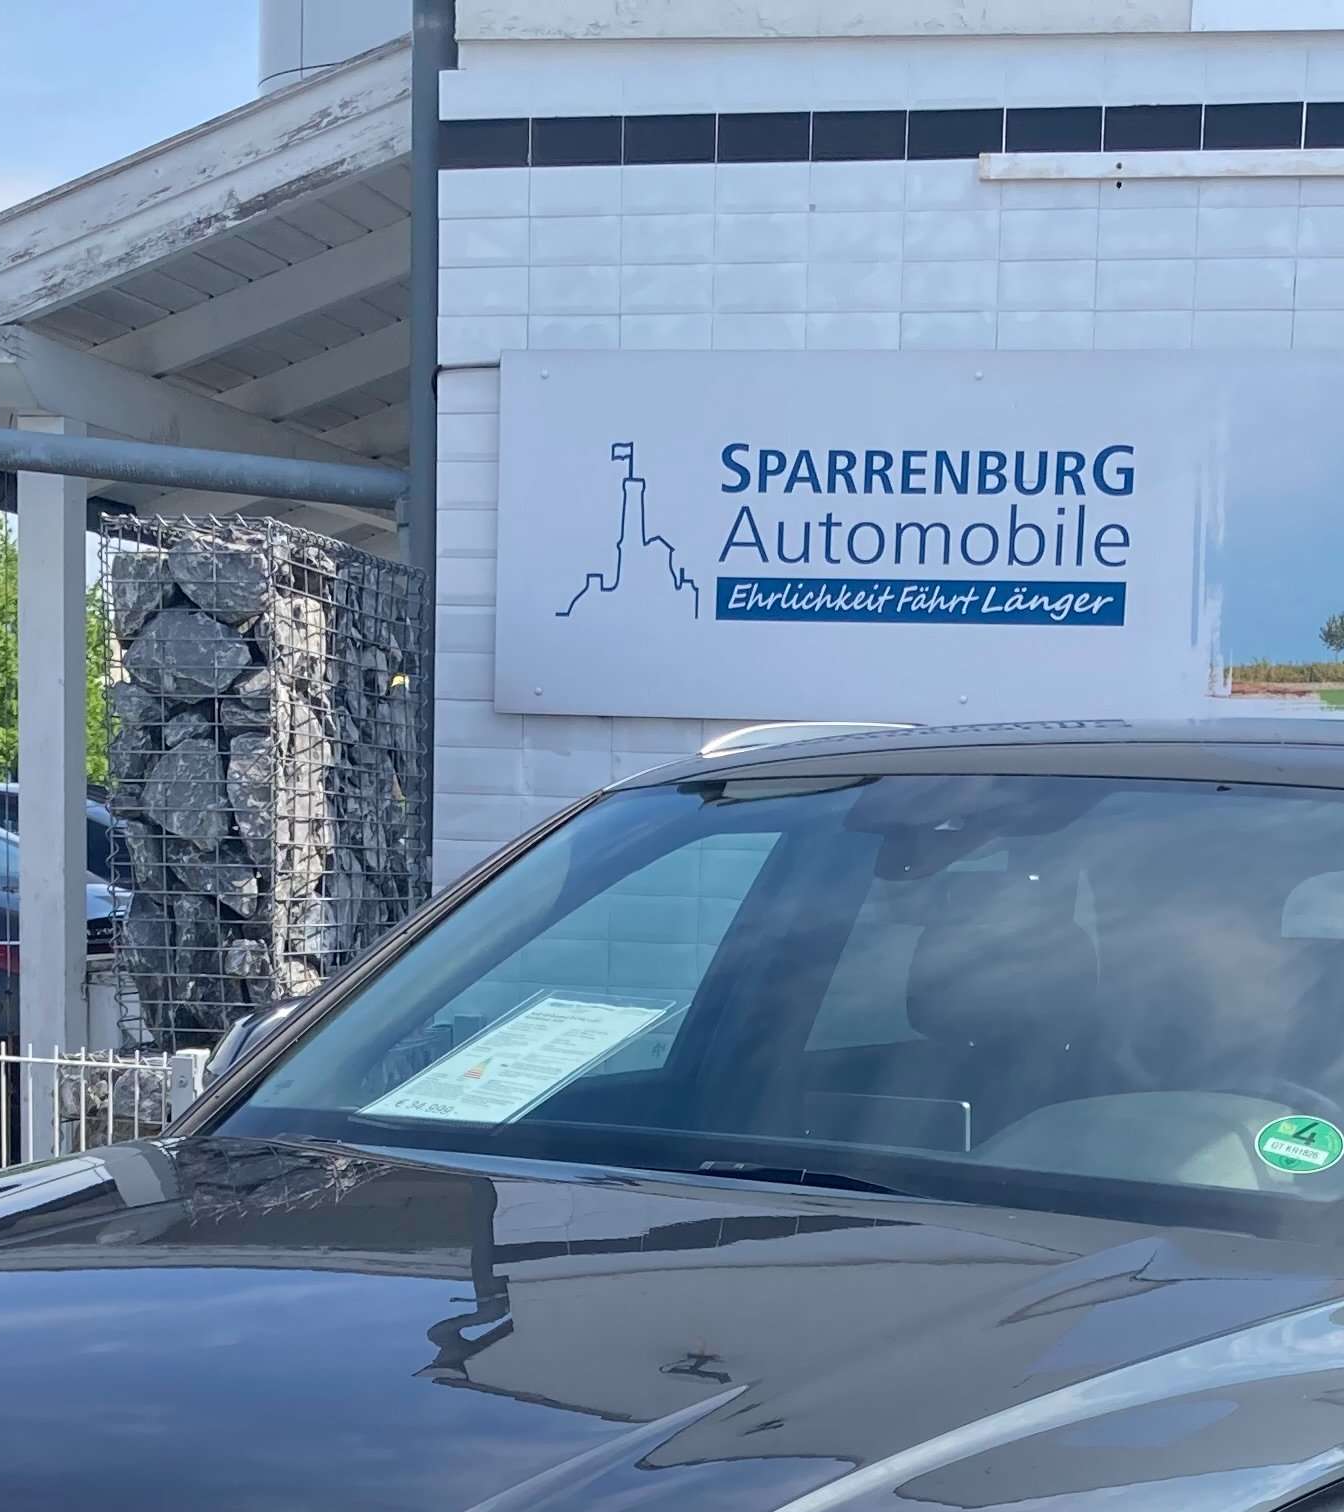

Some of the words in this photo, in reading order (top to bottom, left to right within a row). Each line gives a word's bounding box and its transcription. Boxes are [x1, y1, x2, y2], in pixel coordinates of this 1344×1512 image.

[720, 442, 1136, 497] SPARRENBURG
[718, 504, 1131, 567] Automobile
[728, 583, 894, 613] Ehrlichkeit
[896, 585, 980, 615] Fährt
[980, 586, 1115, 621] Länger
[1293, 1122, 1320, 1146] 4
